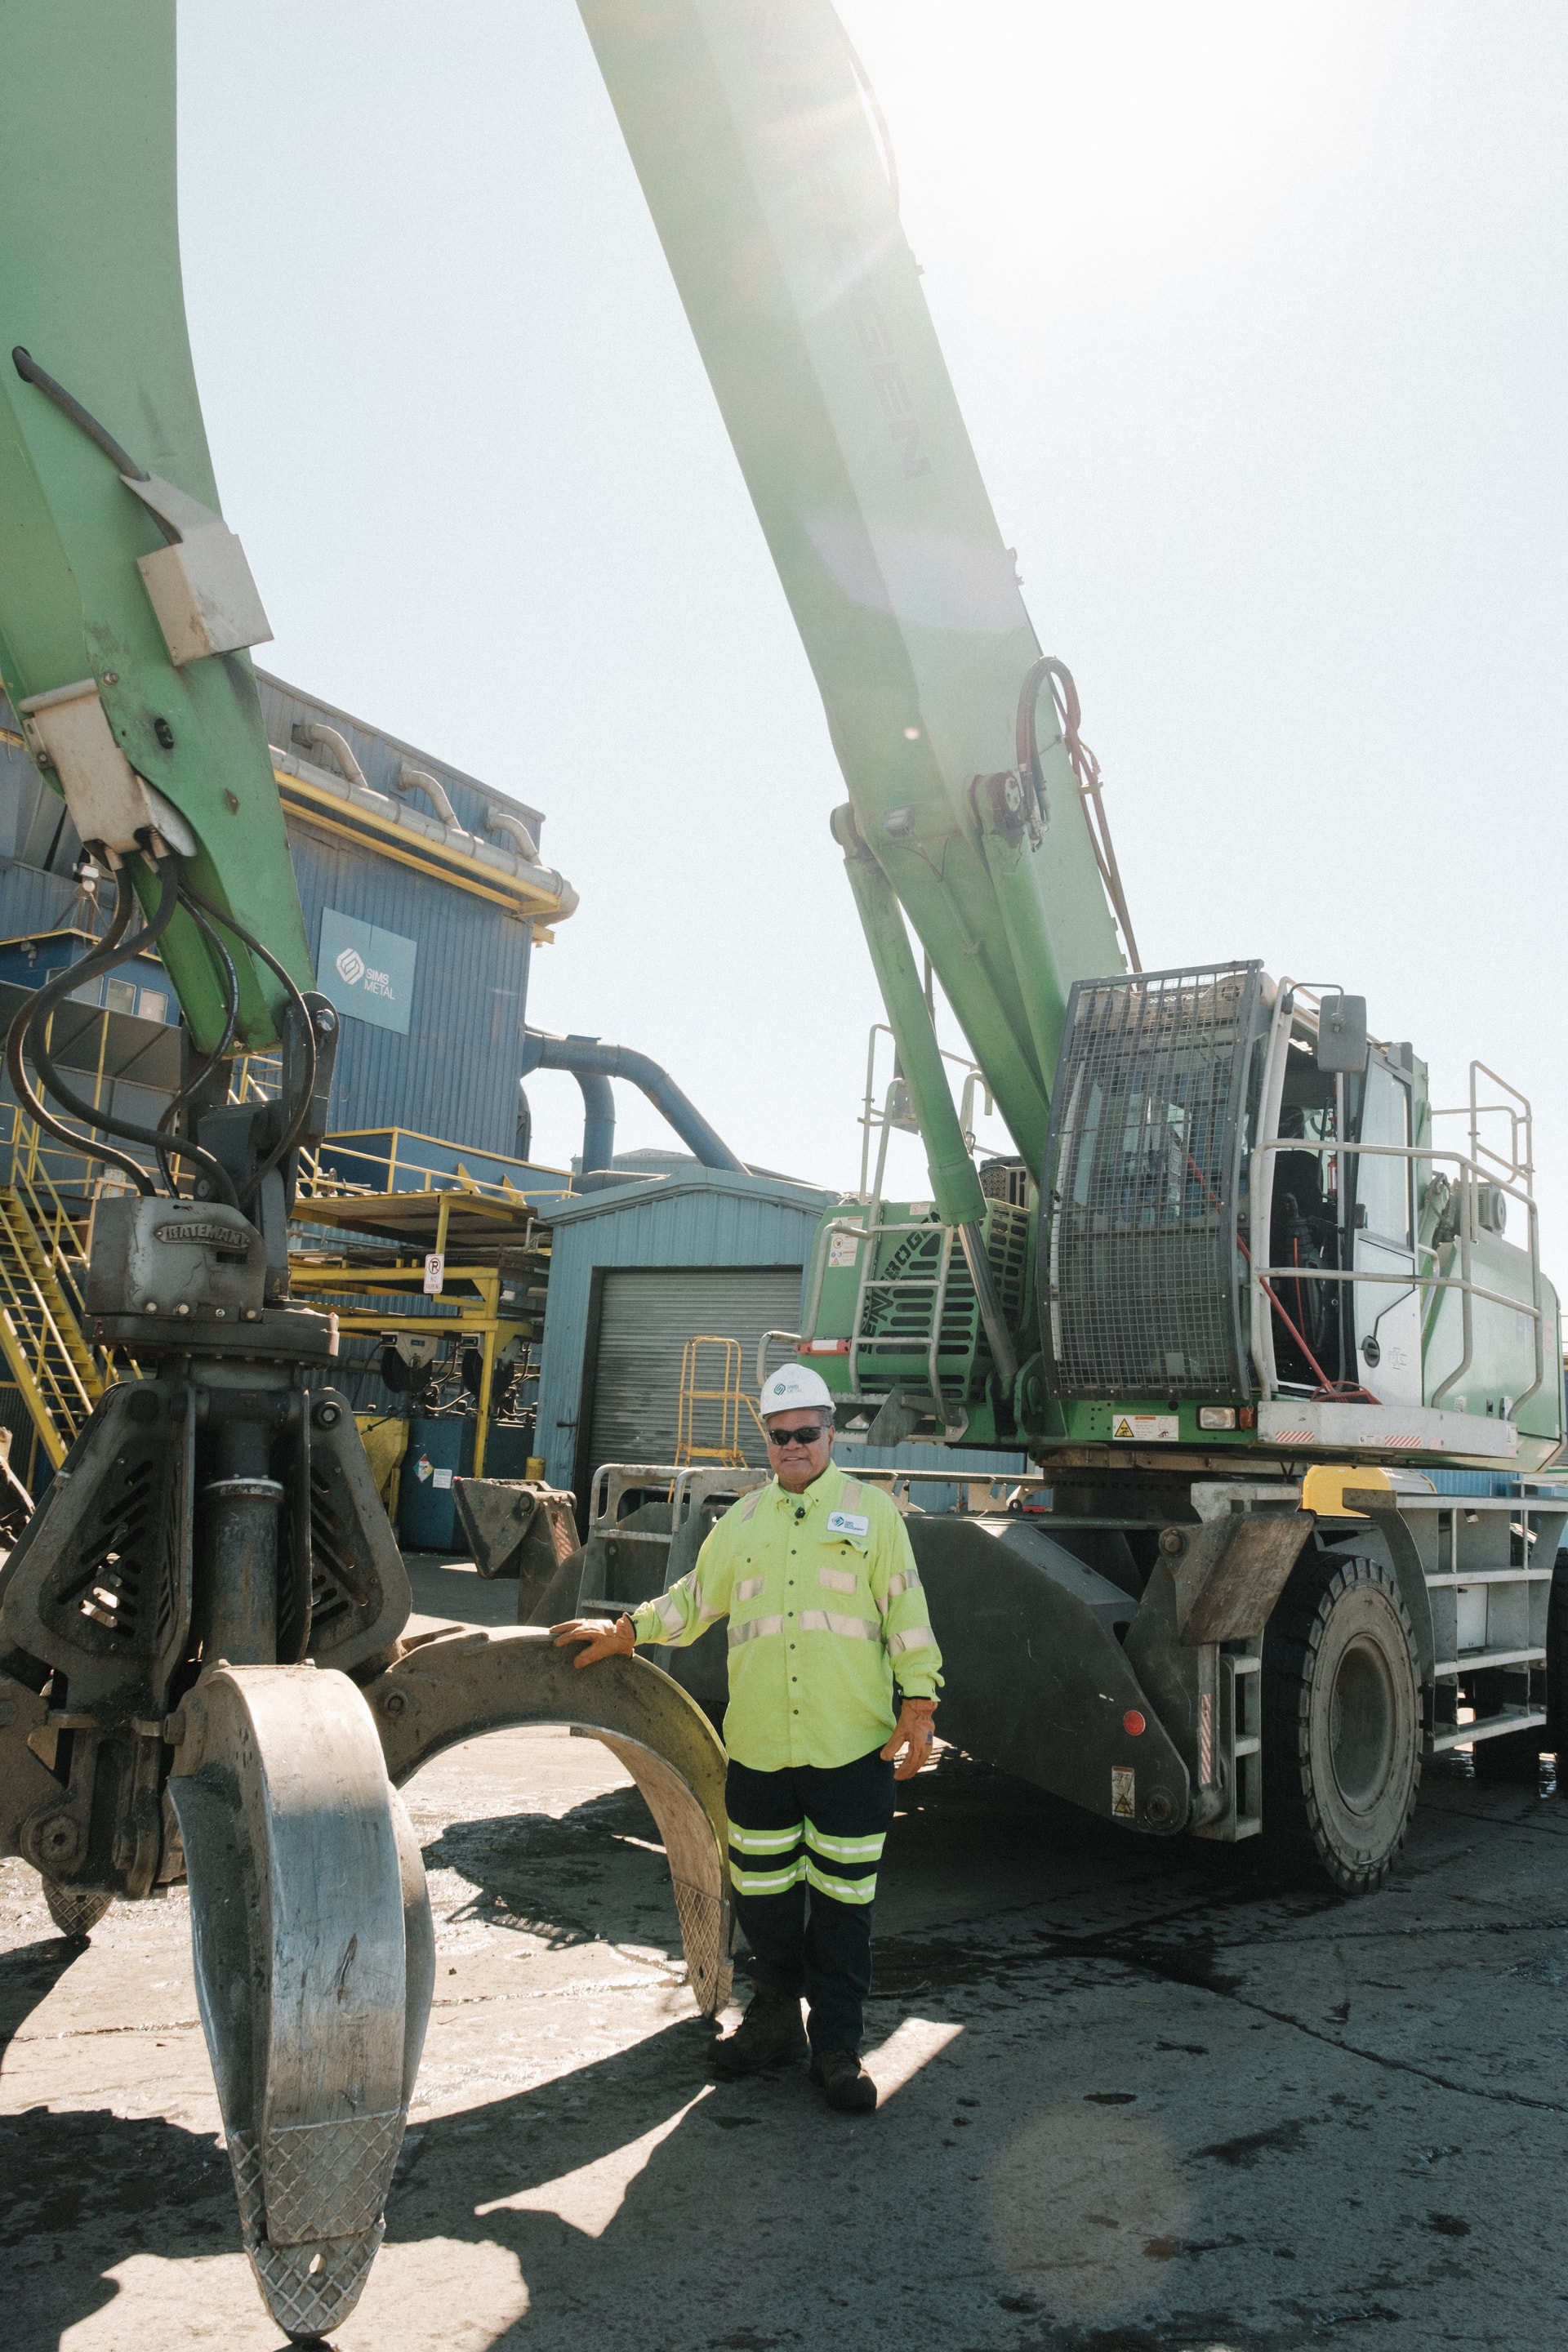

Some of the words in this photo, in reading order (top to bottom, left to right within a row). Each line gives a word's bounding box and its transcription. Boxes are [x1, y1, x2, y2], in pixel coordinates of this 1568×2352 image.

[366, 968, 390, 984] SIMS
[363, 979, 395, 1000] METAL
[167, 1225, 242, 1244] BATEMAN
